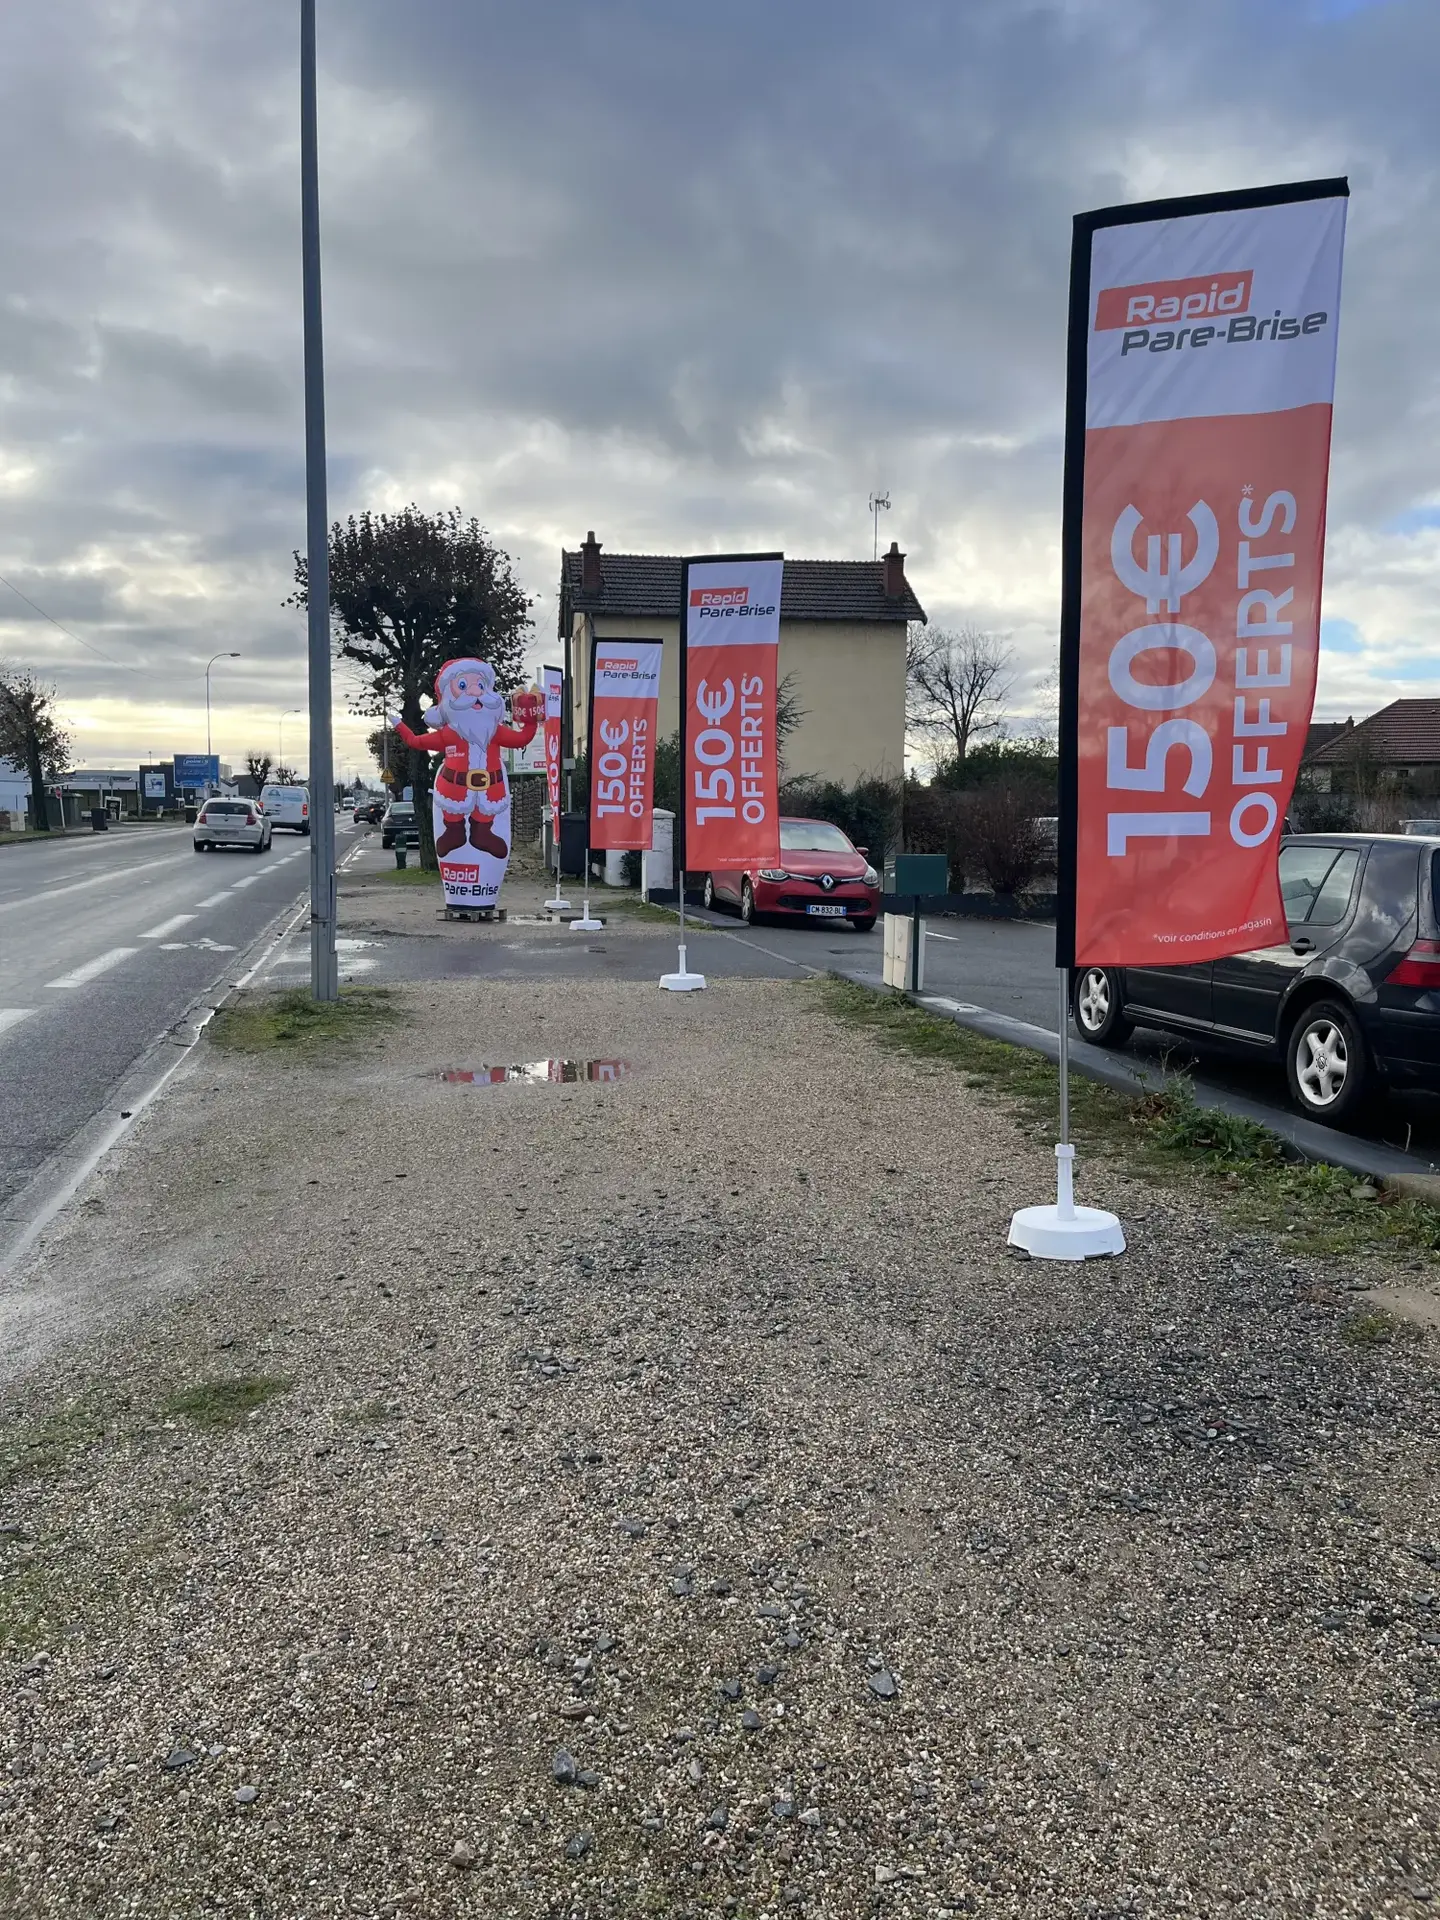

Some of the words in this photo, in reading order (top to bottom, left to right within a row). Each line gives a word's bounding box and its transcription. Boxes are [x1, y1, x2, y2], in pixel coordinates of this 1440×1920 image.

[1126, 282, 1245, 323] Rapid
[1121, 310, 1327, 356] Pare-Brise
[702, 591, 746, 604] Rapid
[700, 604, 775, 618] Pare-Brise
[605, 661, 637, 670] Rapid
[603, 671, 657, 680] Pare-Brise
[1107, 500, 1219, 856] 150€
[695, 678, 736, 825] 150€
[597, 718, 629, 818] 150€
[443, 867, 478, 881] Rapid
[445, 883, 499, 896] Pare-Brise
[1179, 930, 1226, 942] conditions
[1227, 927, 1238, 935] en
